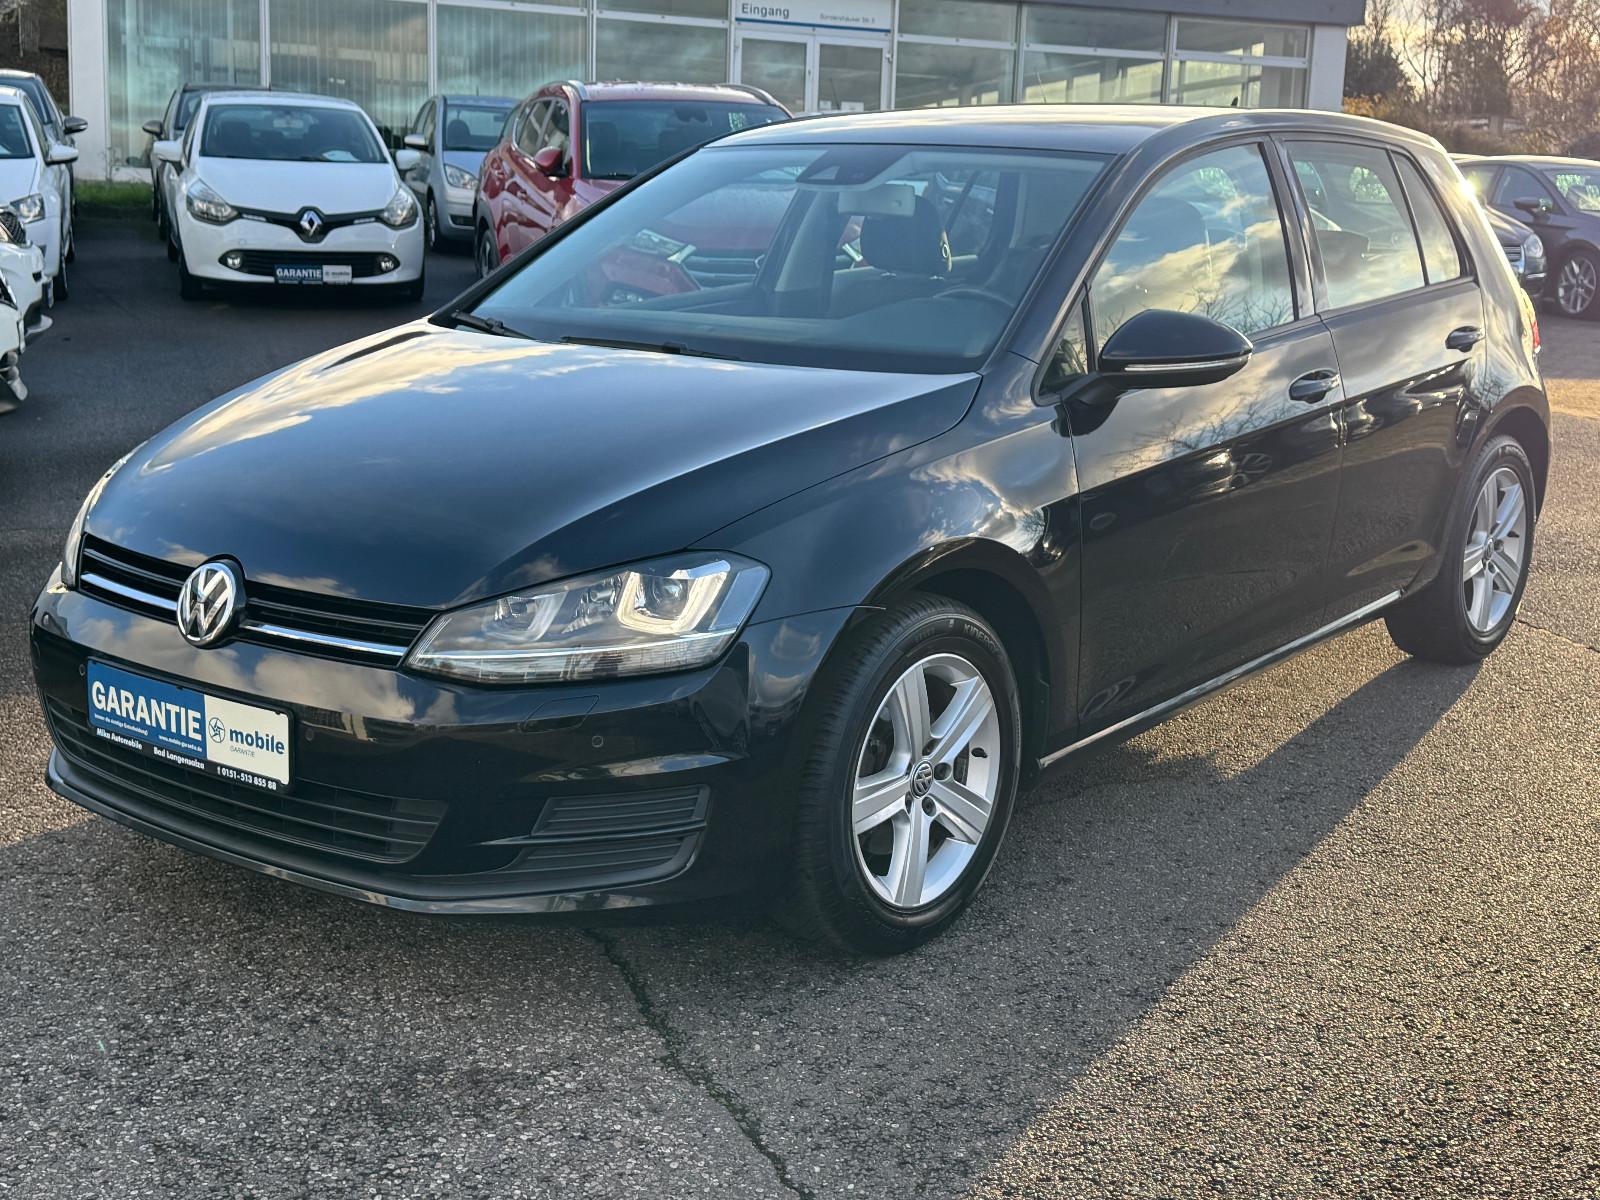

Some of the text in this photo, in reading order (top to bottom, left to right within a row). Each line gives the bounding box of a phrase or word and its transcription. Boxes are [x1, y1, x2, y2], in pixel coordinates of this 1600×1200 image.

[741, 3, 789, 18] Eingang
[276, 268, 322, 278] GARANTIE
[91, 680, 202, 741] GARANTIE
[111, 733, 143, 750] Automobile
[229, 728, 285, 755] mobile
[153, 746, 166, 758] Bad
[229, 745, 256, 758] GARANTIE
